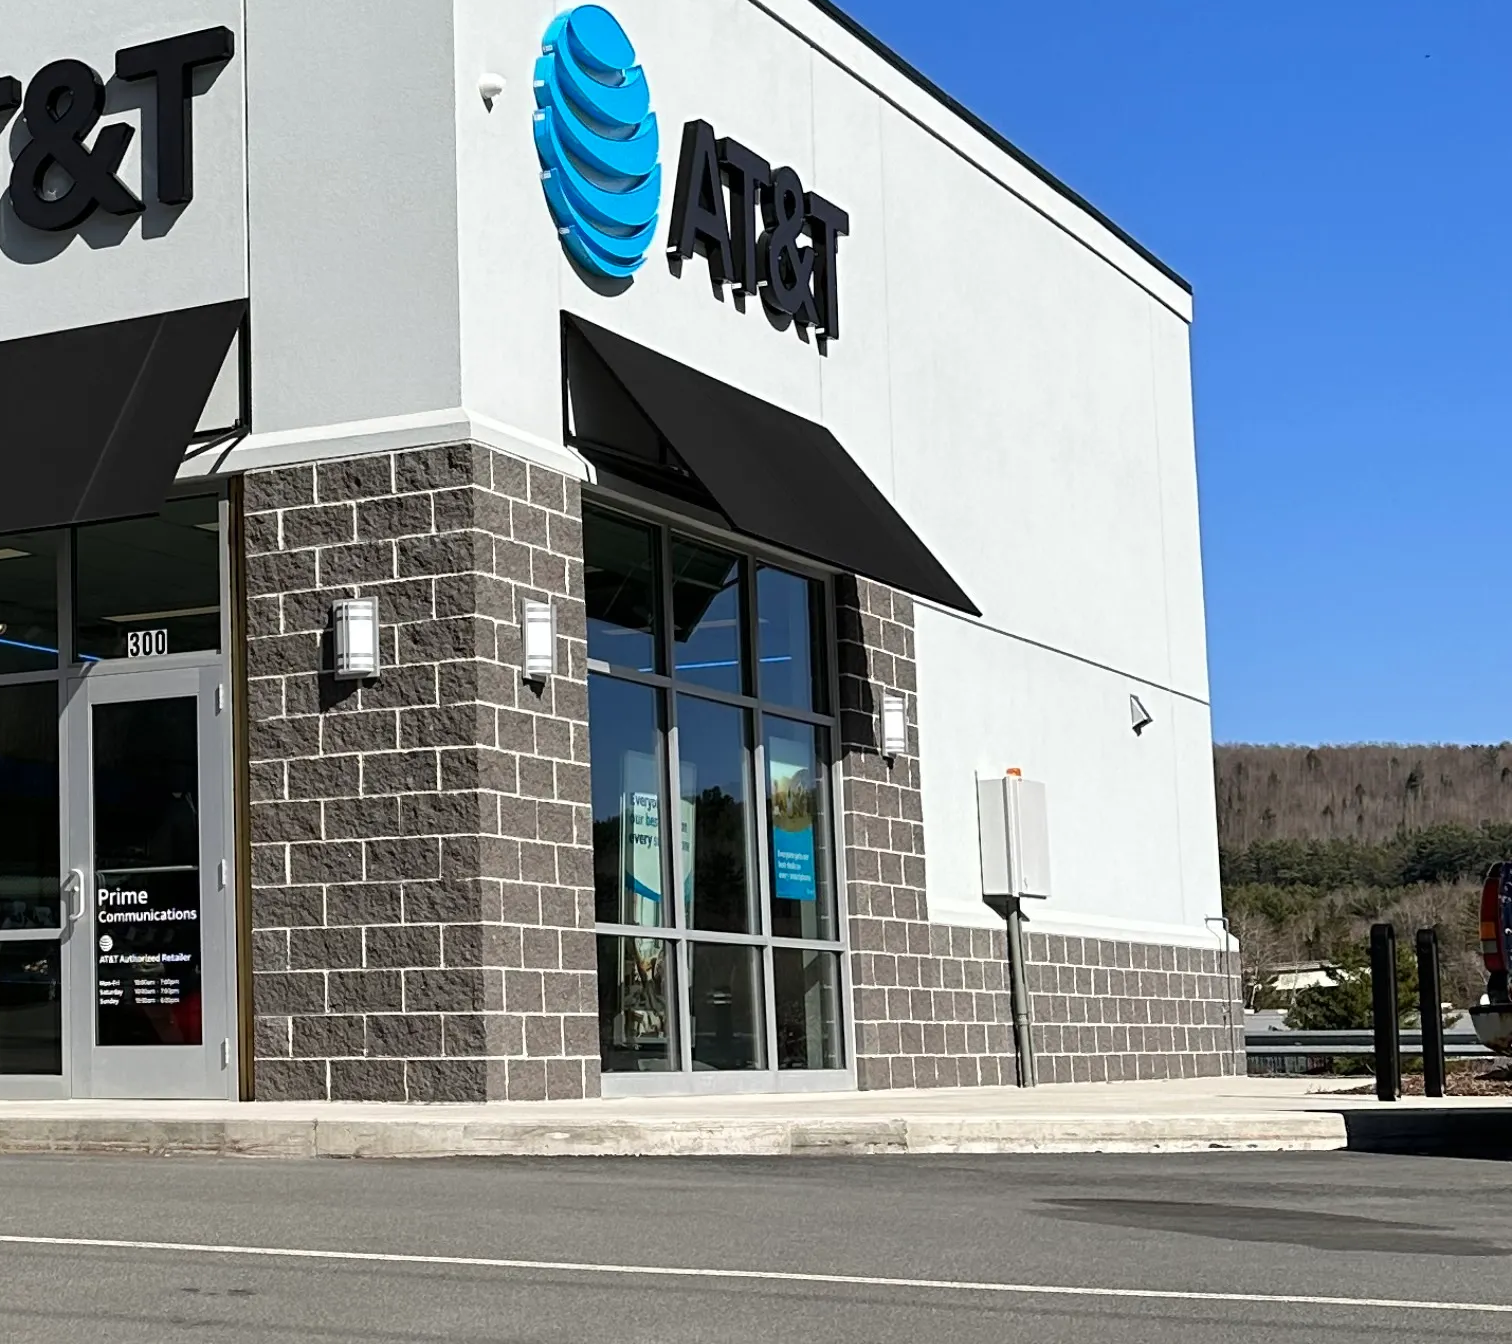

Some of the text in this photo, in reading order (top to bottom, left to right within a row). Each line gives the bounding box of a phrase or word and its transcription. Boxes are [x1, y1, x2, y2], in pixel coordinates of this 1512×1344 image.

[666, 118, 849, 340] AT&T
[129, 630, 166, 657] 300
[629, 833, 653, 850] every
[98, 887, 148, 906] Prime
[98, 908, 197, 923] Communications
[99, 953, 192, 964] AT&T Authorized Retailer
